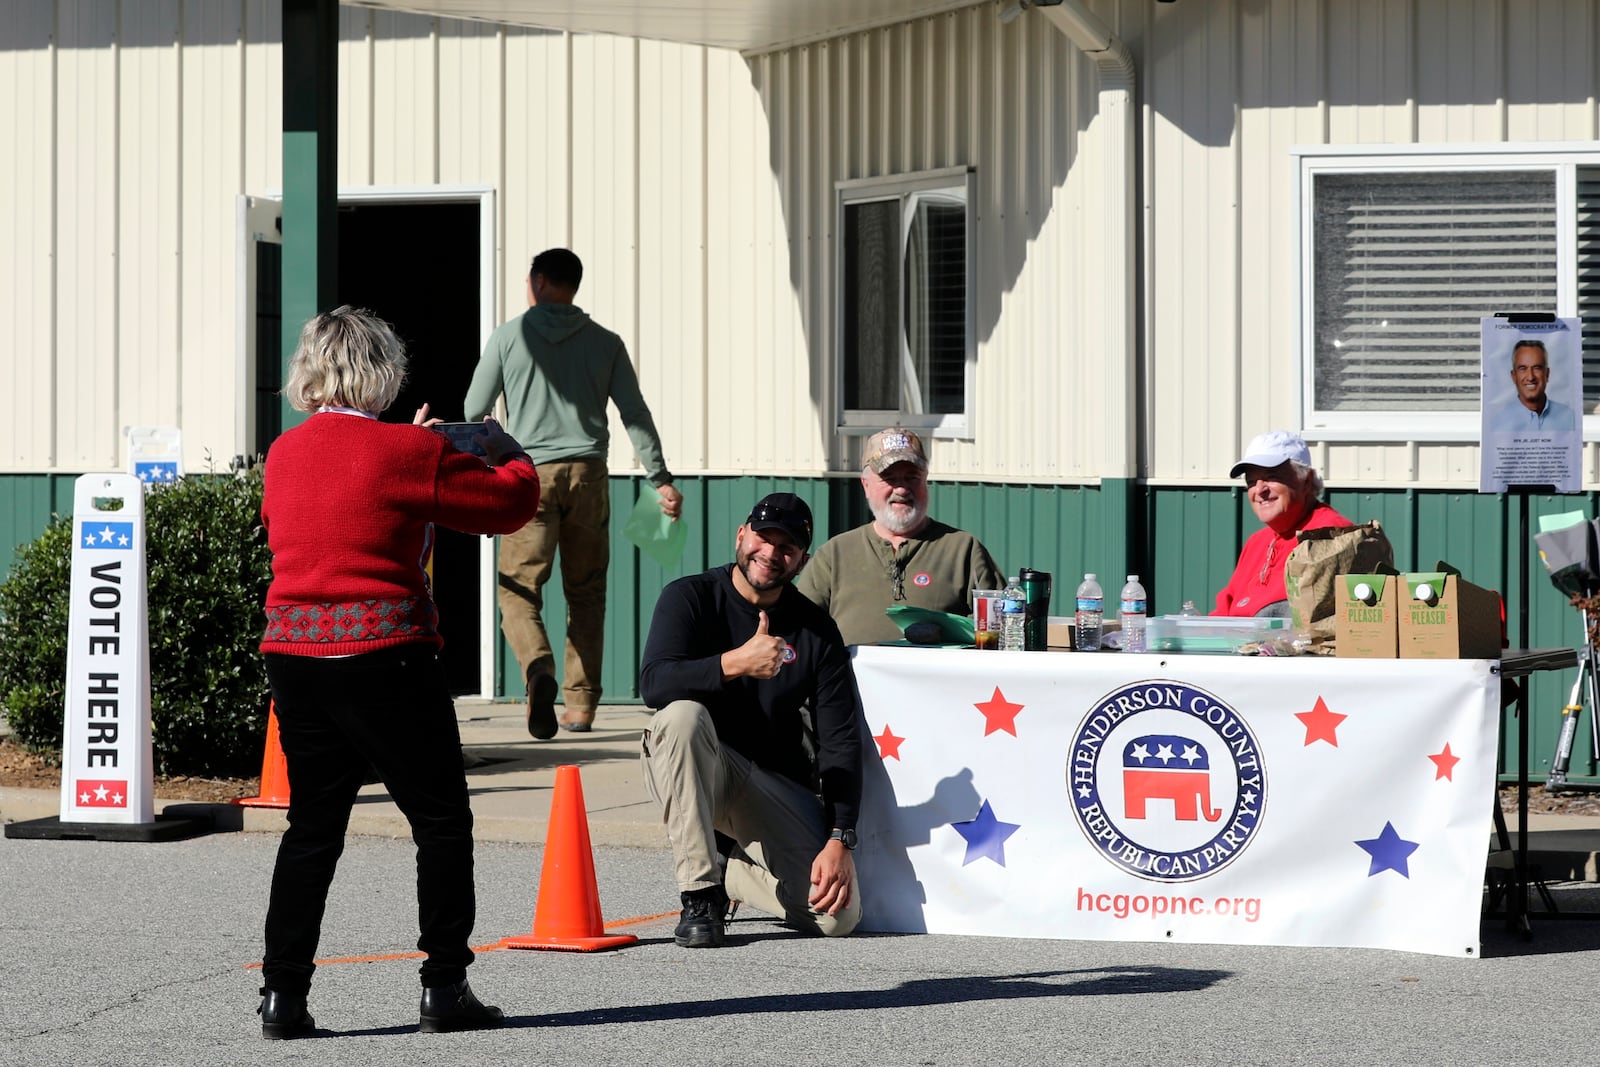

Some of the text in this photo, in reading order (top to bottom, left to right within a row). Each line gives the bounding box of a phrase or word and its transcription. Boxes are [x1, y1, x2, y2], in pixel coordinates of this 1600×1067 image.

[1348, 608, 1383, 623] PLEASER
[1411, 610, 1446, 625] PLEASER
[87, 560, 122, 769] VOTE HERE
[1074, 687, 1261, 791] HENDERSON COUNTY
[1080, 801, 1258, 876] REPUBLICAN PARTY
[1076, 887, 1261, 923] hcgopnc.org
